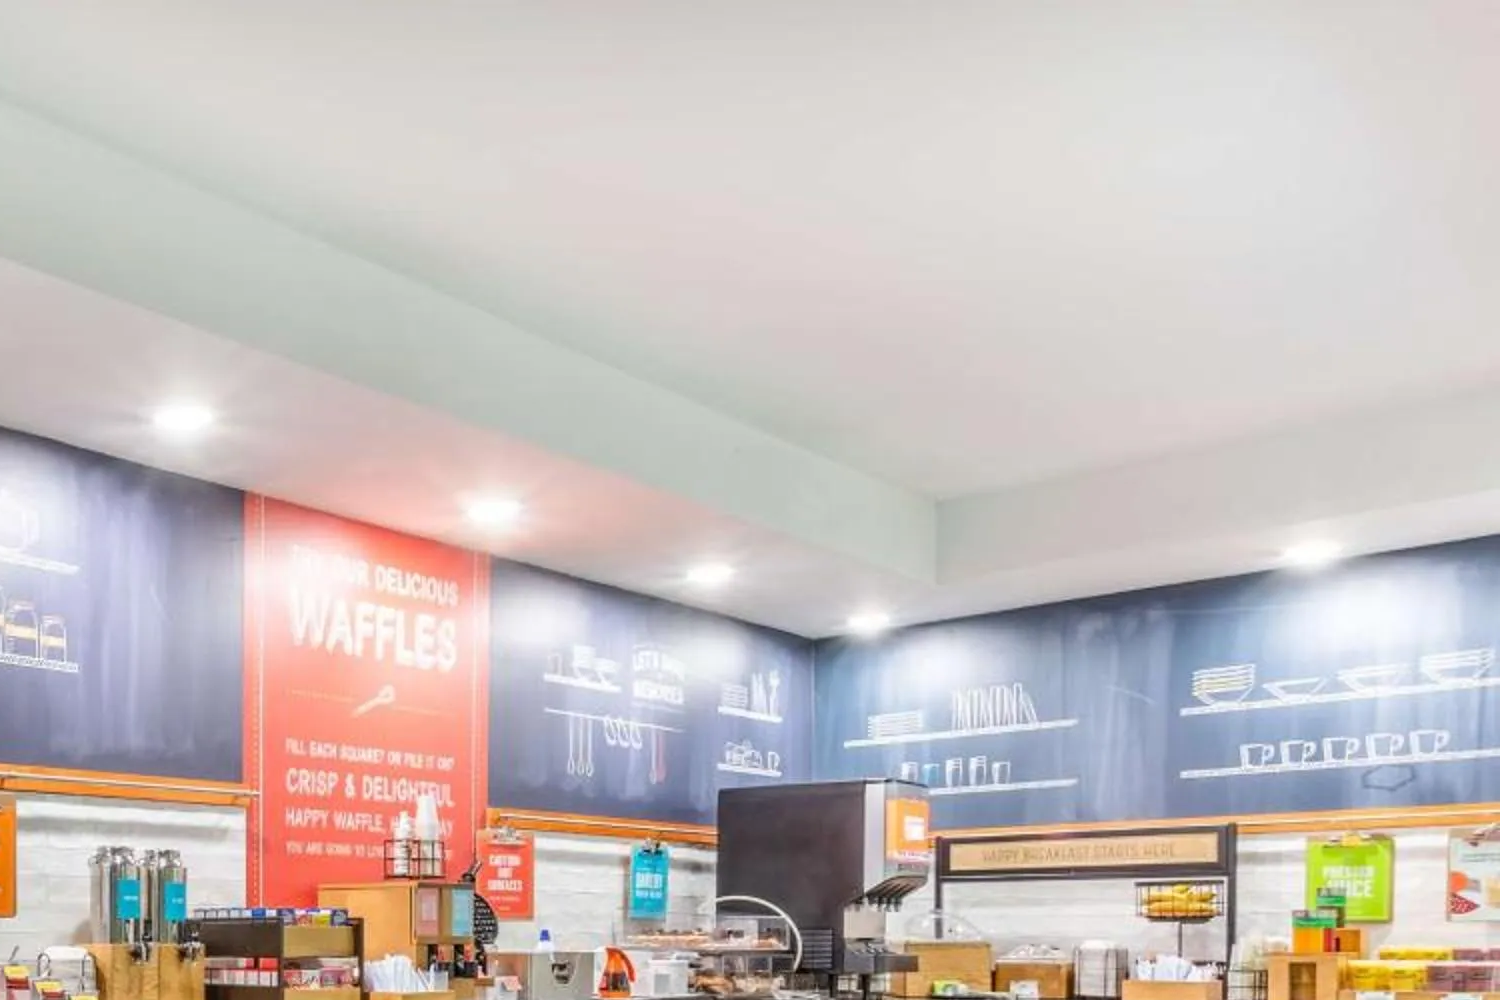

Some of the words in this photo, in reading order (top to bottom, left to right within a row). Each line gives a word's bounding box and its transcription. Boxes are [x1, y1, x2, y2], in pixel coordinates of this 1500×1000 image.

[374, 564, 459, 607] DELICIOUS
[289, 584, 458, 673] WAFFLES
[309, 740, 337, 760] EACH
[285, 767, 339, 796] CRISP
[344, 773, 356, 799] &
[362, 775, 456, 808] DELIGHTFUL
[285, 807, 329, 829] HAPPY
